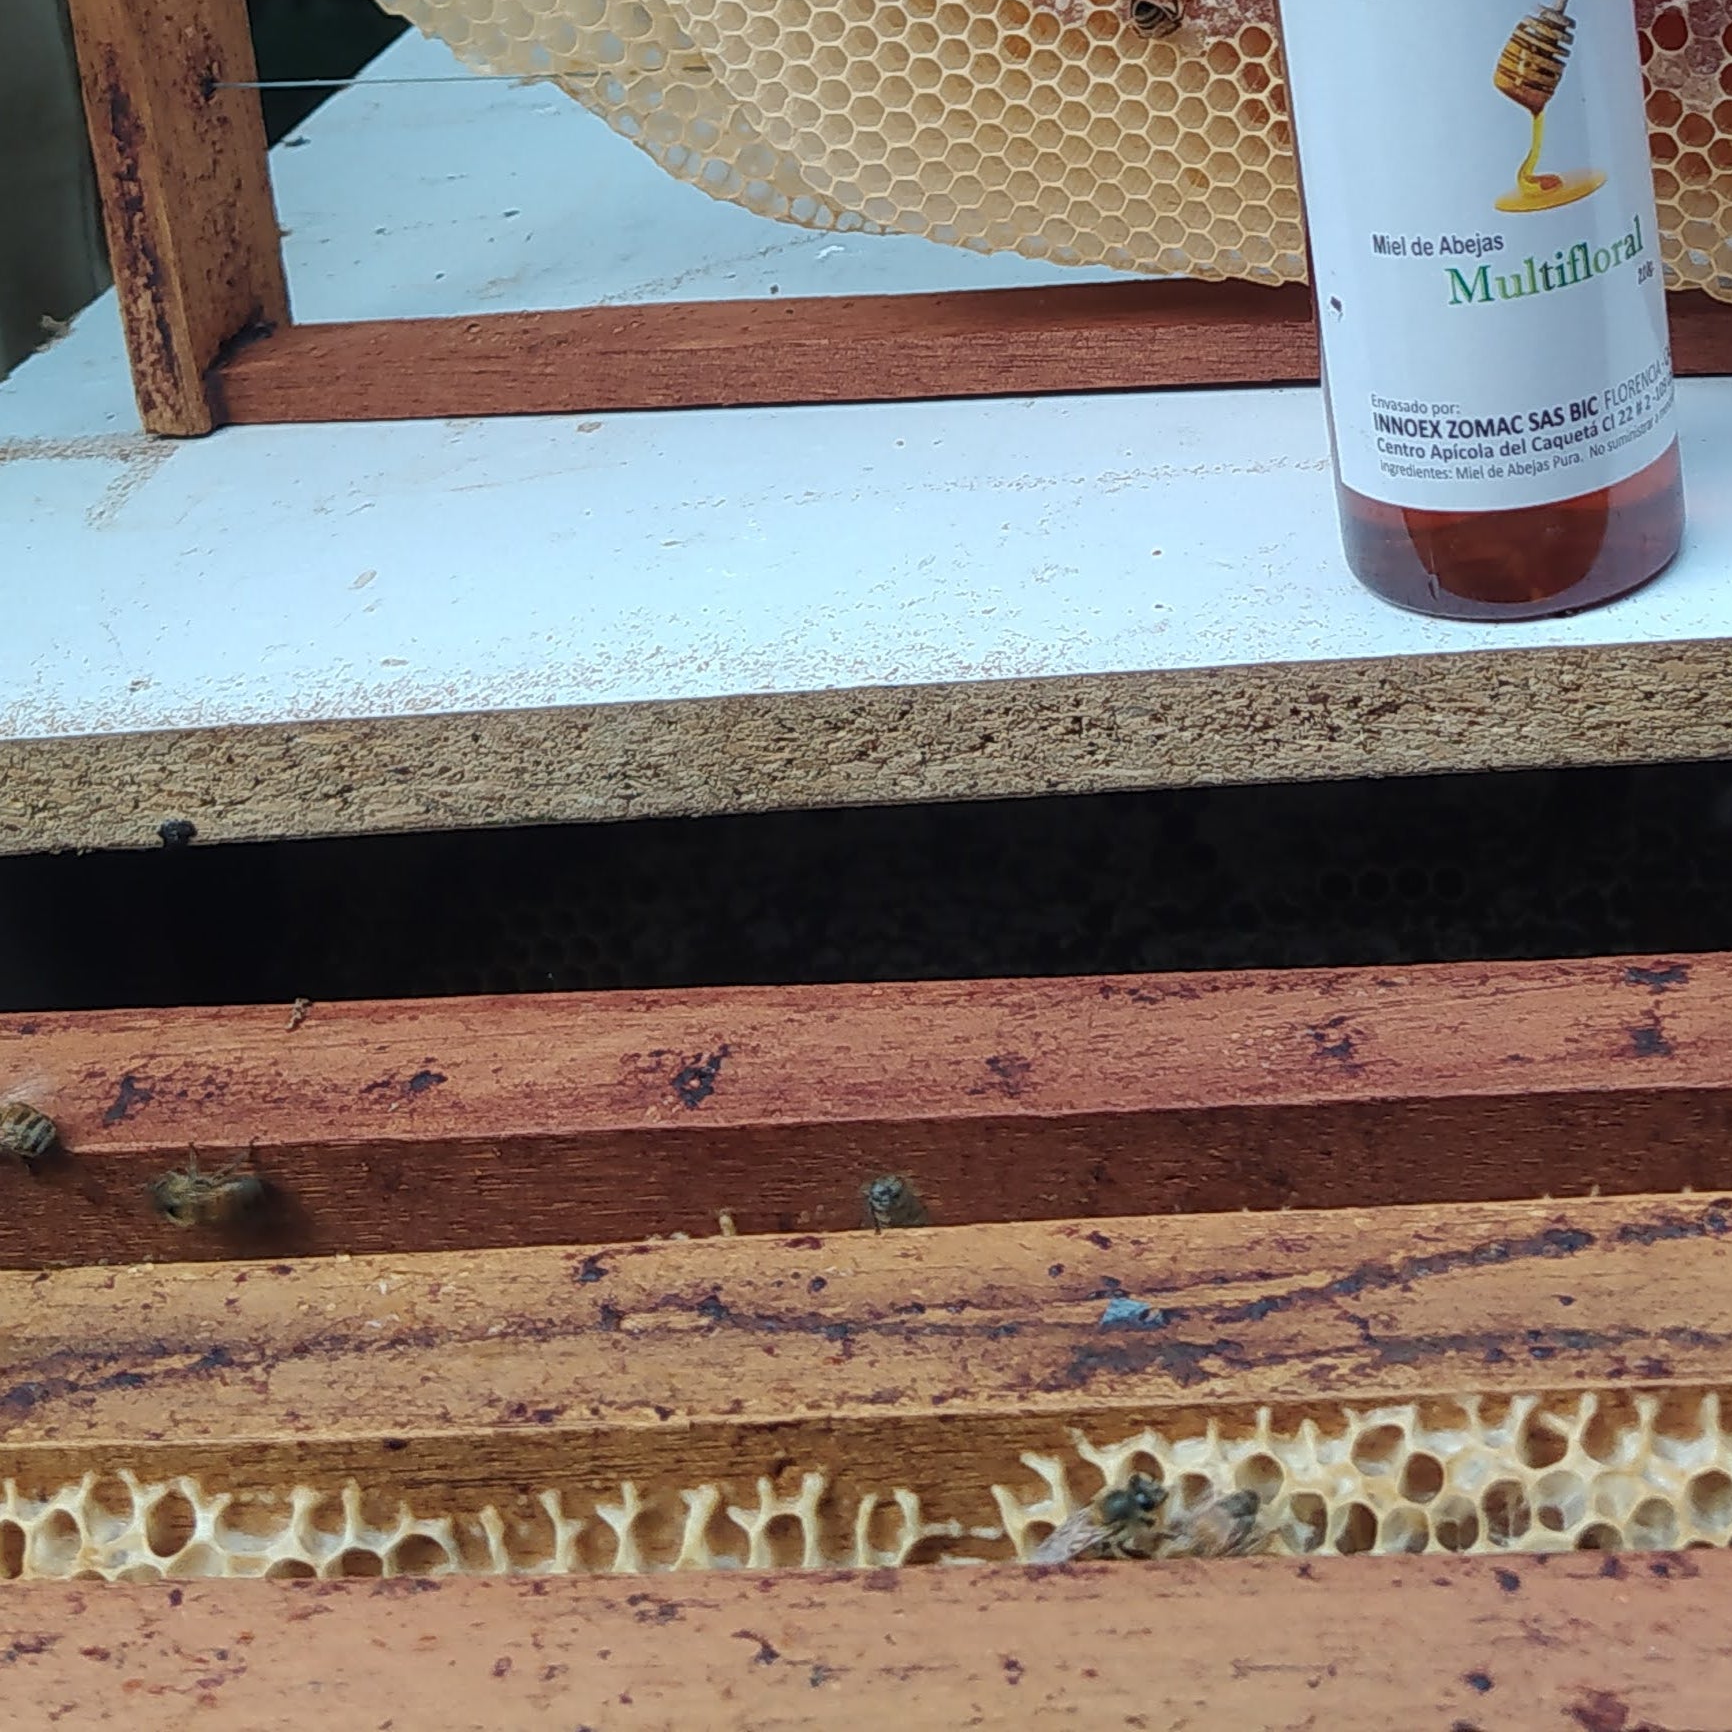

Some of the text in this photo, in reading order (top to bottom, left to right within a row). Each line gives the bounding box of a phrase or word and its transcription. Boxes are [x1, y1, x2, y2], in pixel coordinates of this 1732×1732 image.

[1373, 234, 1504, 258] Miel de Abejas
[1445, 214, 1644, 304] Multifloral
[1371, 394, 1460, 417] Envasado por:
[1373, 412, 1442, 439] INNOEX
[1446, 415, 1524, 439] ZOMAC
[1529, 406, 1566, 432] SAS
[1570, 396, 1599, 422] BIC
[1604, 359, 1661, 410] FLORENCIA
[1377, 437, 1425, 459] Centro
[1430, 443, 1494, 463] Apícola
[1500, 438, 1526, 456] del
[1532, 420, 1598, 452] Caquetá
[1618, 406, 1633, 426] 22
[1456, 465, 1484, 479] Miel
[1489, 465, 1504, 478] de
[1508, 460, 1549, 477] Abejas
[1553, 452, 1583, 469] Pura.
[1589, 444, 1606, 459] No
